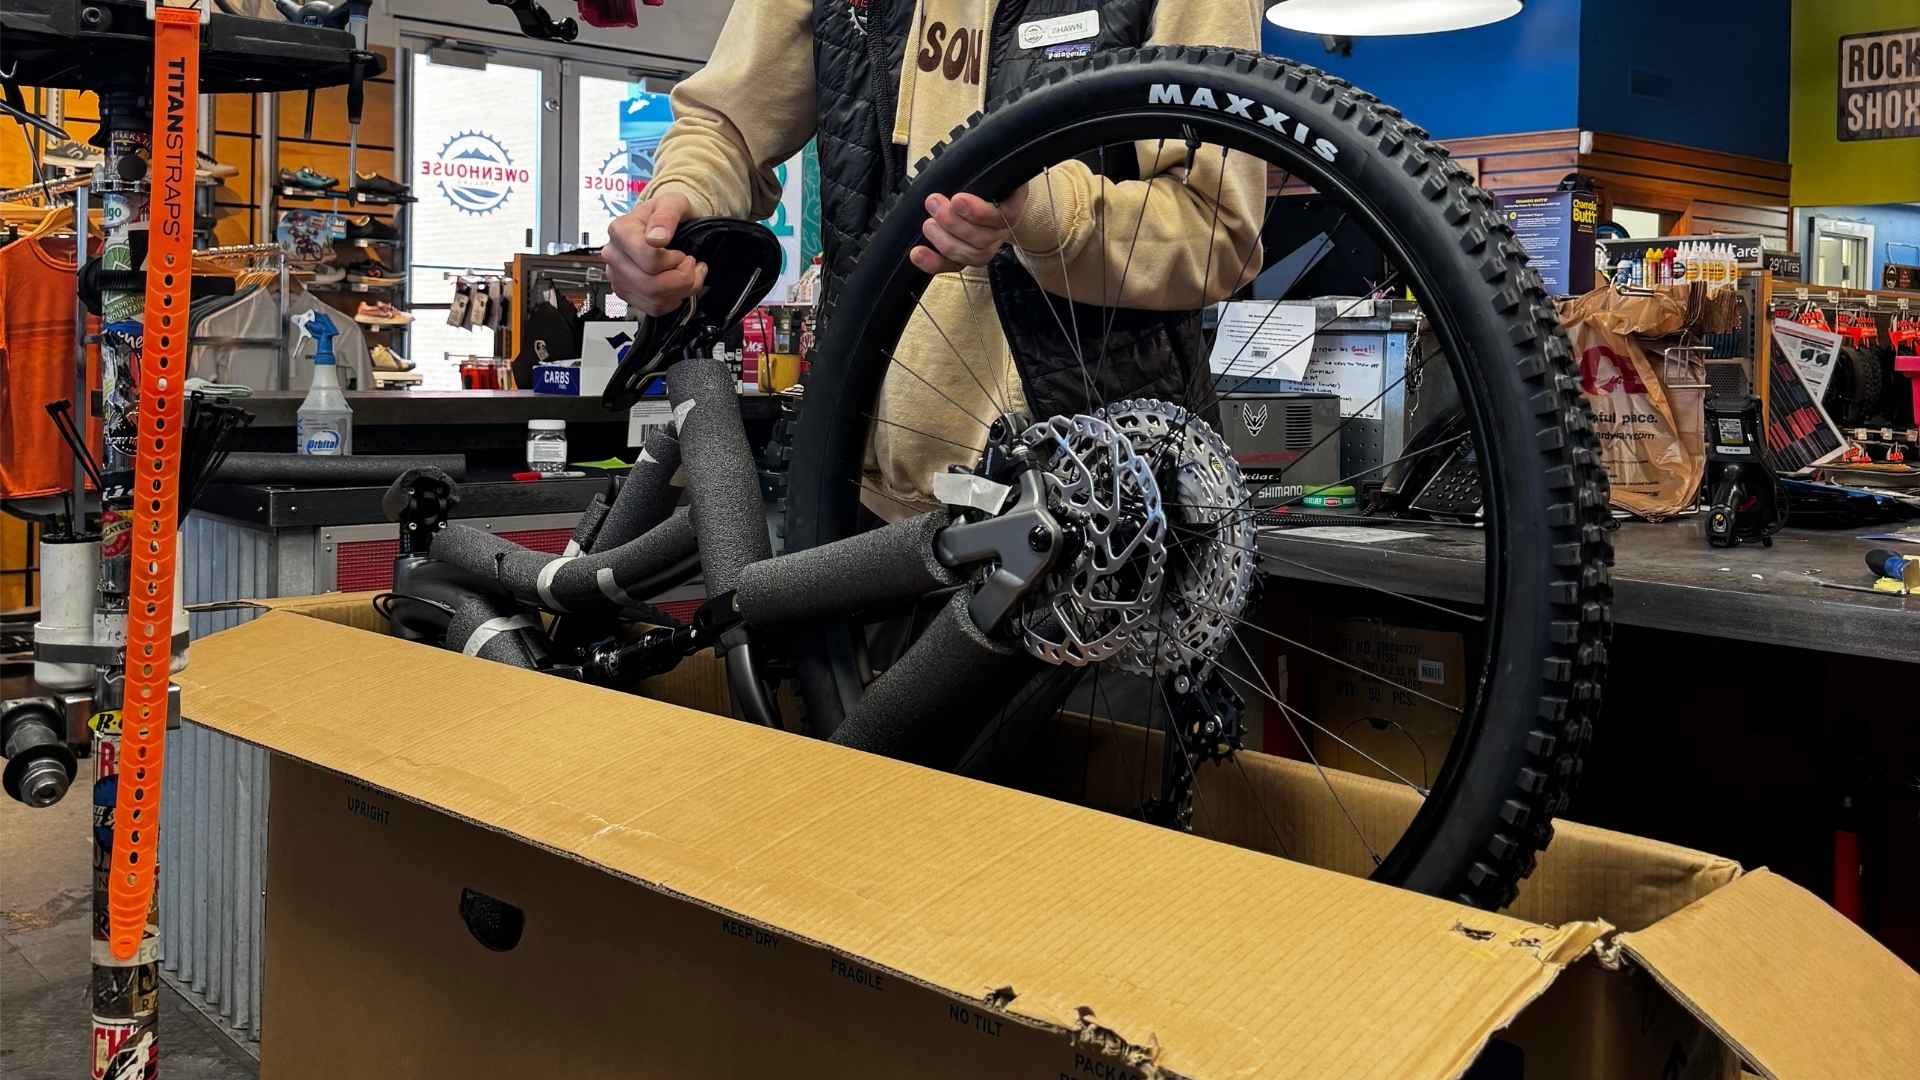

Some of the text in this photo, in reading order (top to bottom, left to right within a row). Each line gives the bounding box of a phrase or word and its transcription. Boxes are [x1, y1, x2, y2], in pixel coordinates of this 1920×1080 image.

[1848, 37, 1920, 82] ROCK
[1148, 83, 1339, 162] MAXXIS
[1847, 88, 1920, 131] SHOX
[544, 371, 570, 384] CARBS
[1258, 484, 1304, 498] SHIMANO
[347, 796, 390, 824] UPRIGHT
[722, 919, 779, 948] KEEP DRY
[831, 958, 883, 990] FRAGILE
[949, 1003, 1004, 1038] NO TILT
